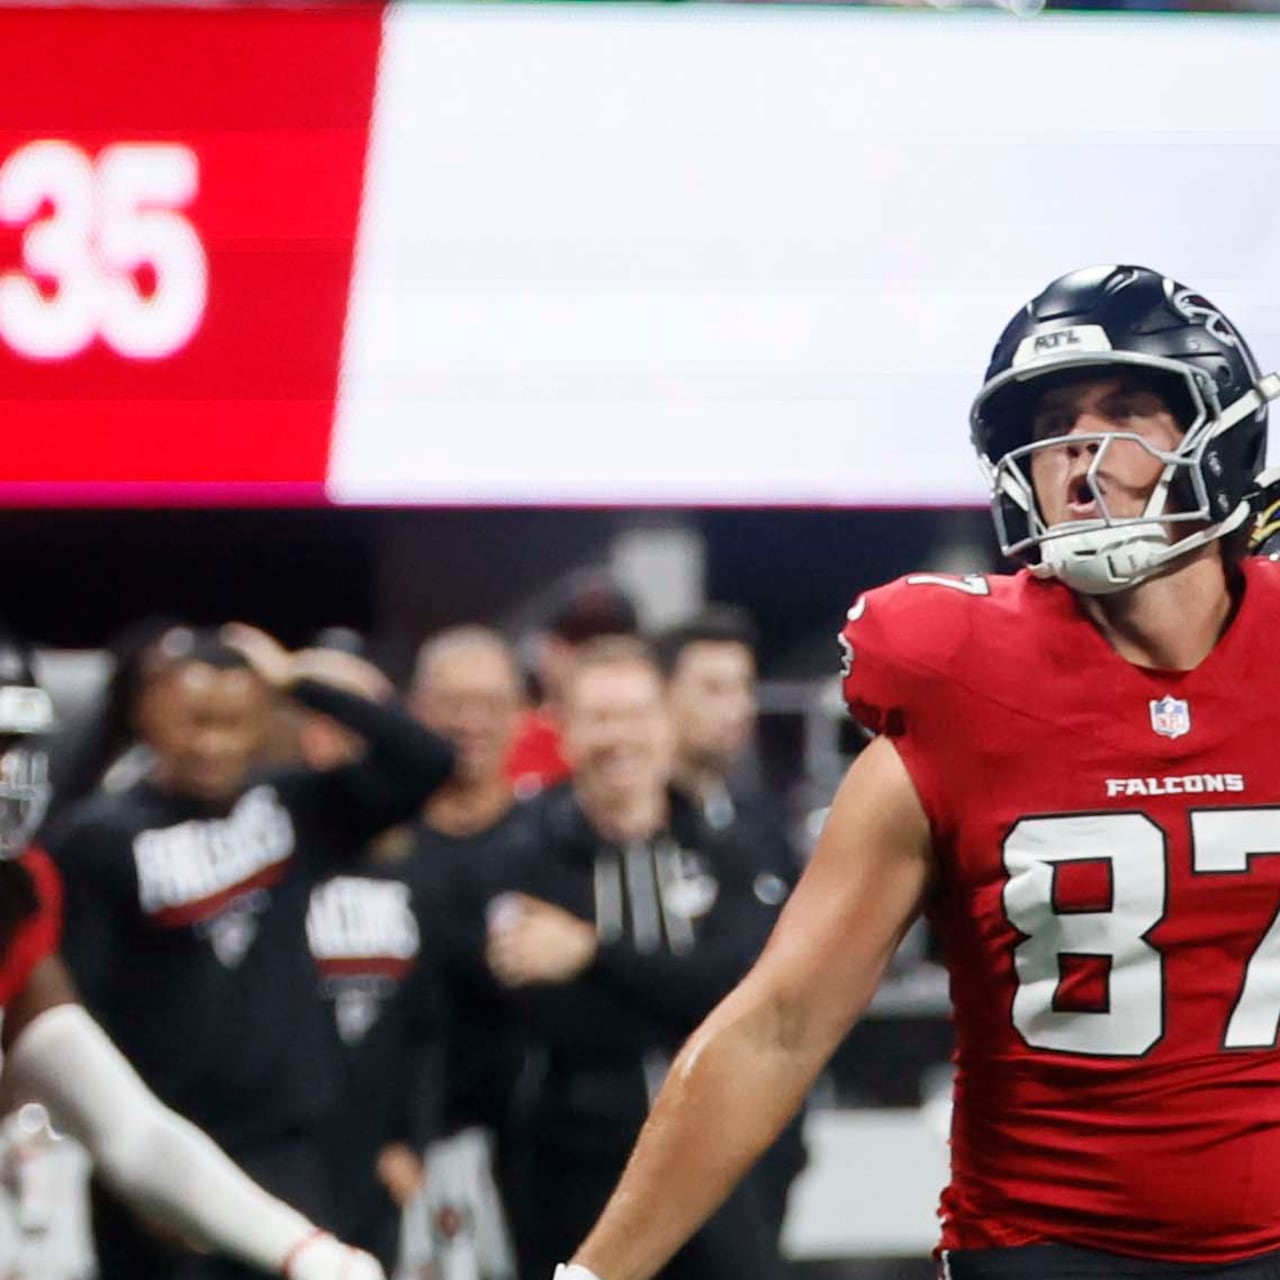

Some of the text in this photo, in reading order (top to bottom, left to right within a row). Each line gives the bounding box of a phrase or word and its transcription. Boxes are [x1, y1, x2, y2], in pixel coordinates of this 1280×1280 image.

[0, 138, 209, 361] 35
[1034, 329, 1080, 352] ATL
[1105, 774, 1244, 797] FALCONS
